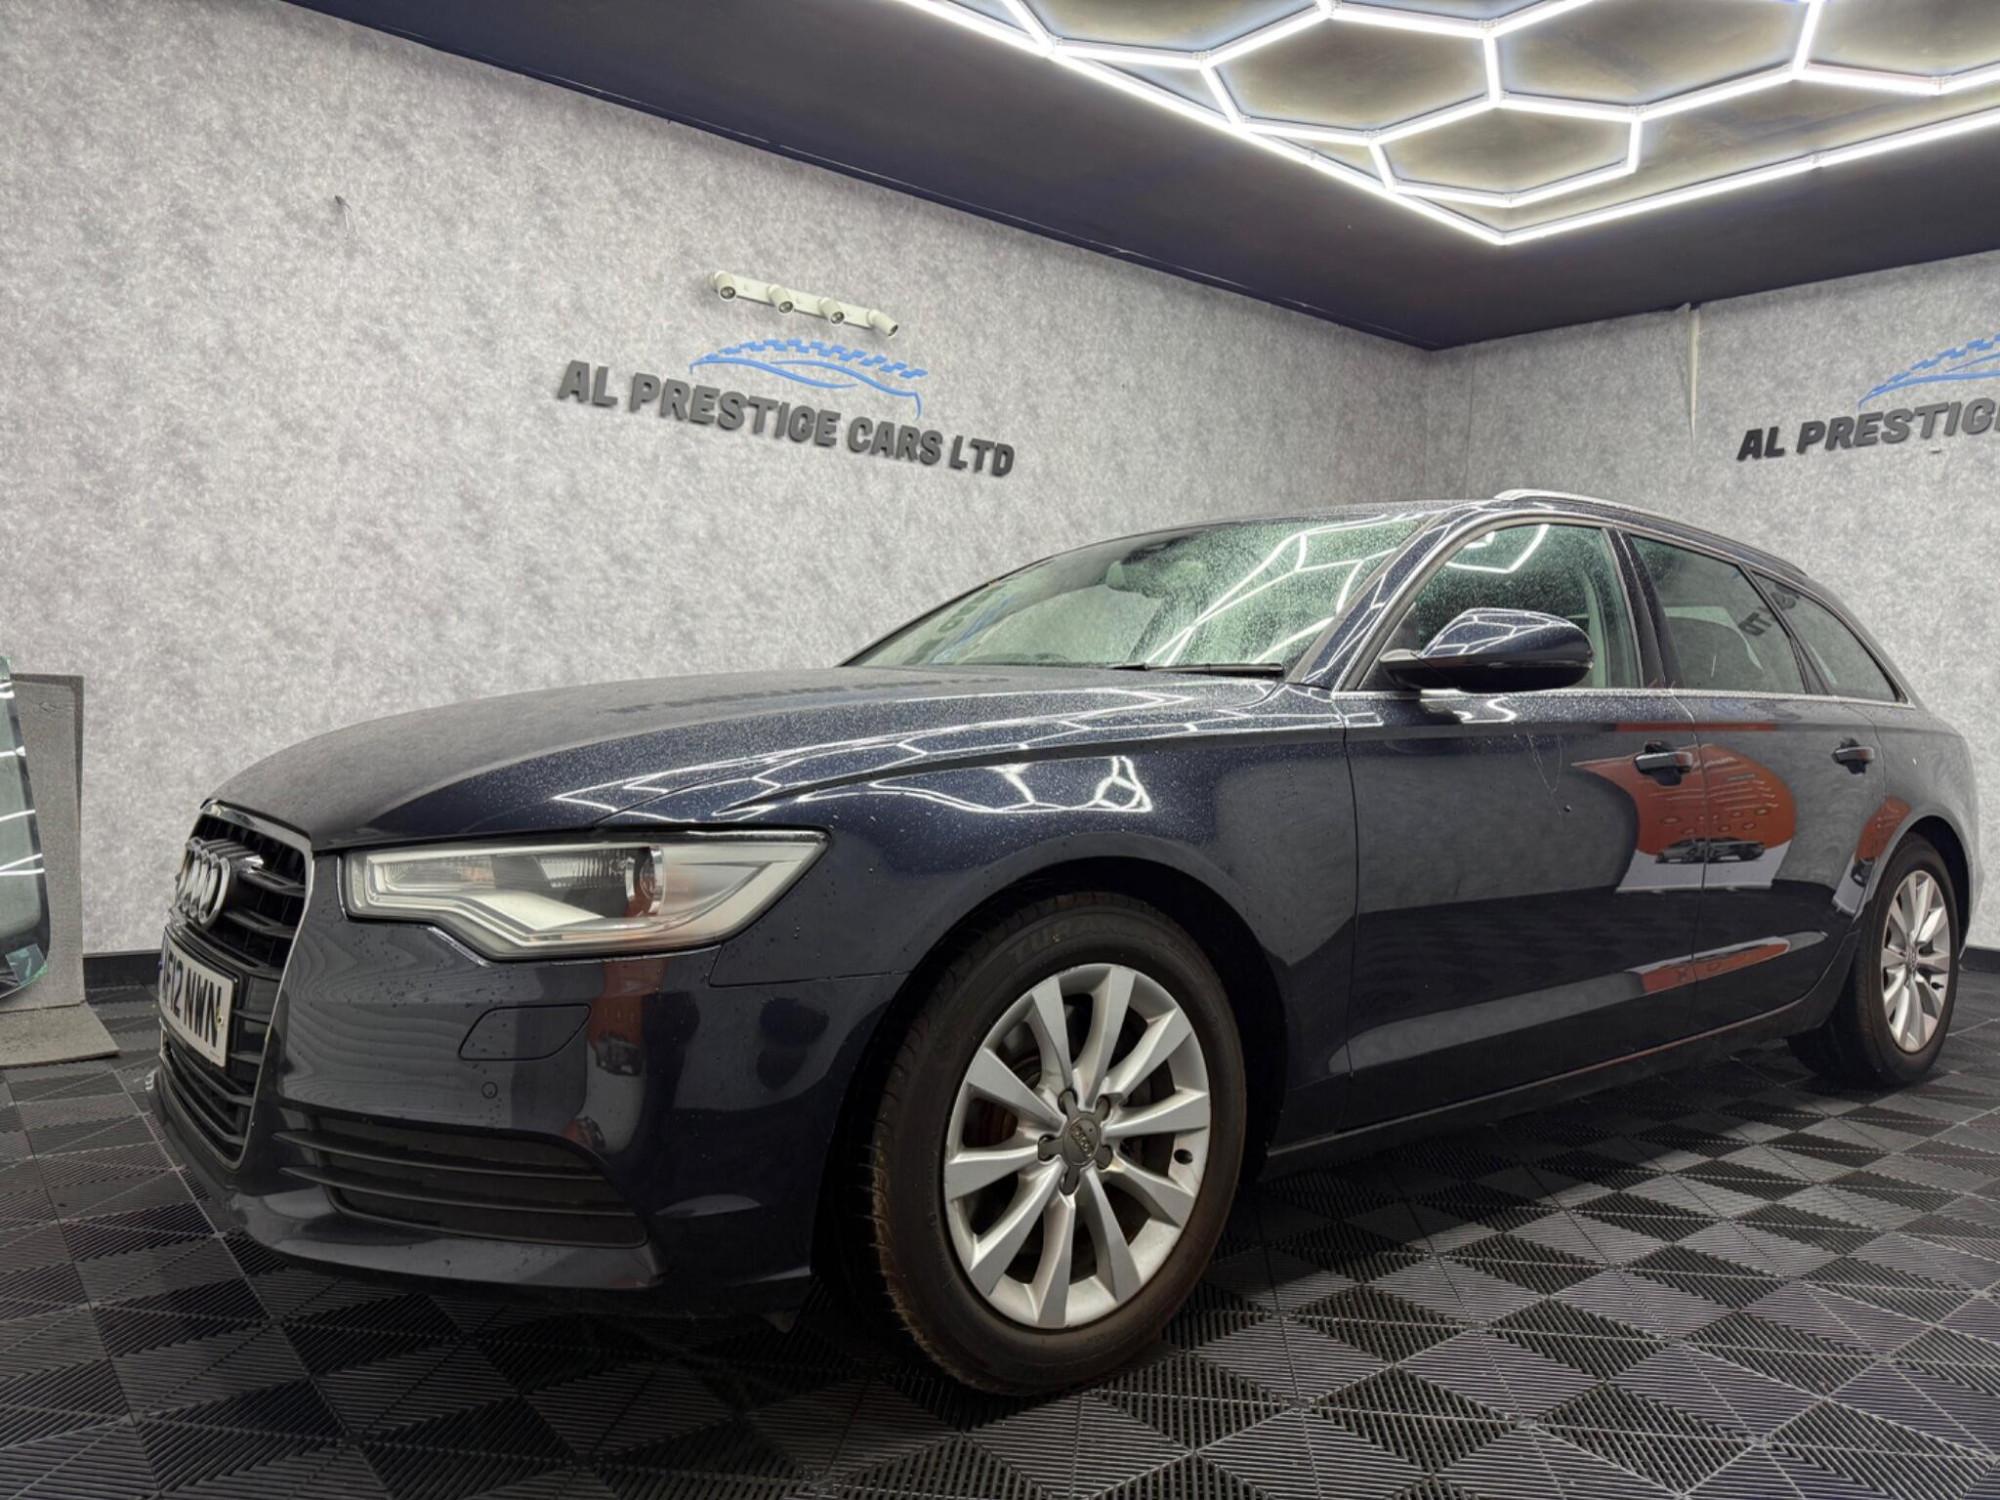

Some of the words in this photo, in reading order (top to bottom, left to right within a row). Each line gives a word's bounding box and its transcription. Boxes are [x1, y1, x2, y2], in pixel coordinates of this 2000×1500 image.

[557, 360, 618, 409] AL
[629, 372, 841, 448] PRESTIGE
[847, 416, 943, 466] CARS
[949, 435, 1015, 477] LTD
[1736, 426, 1786, 461] AL
[1796, 397, 2000, 454] PRESTIG
